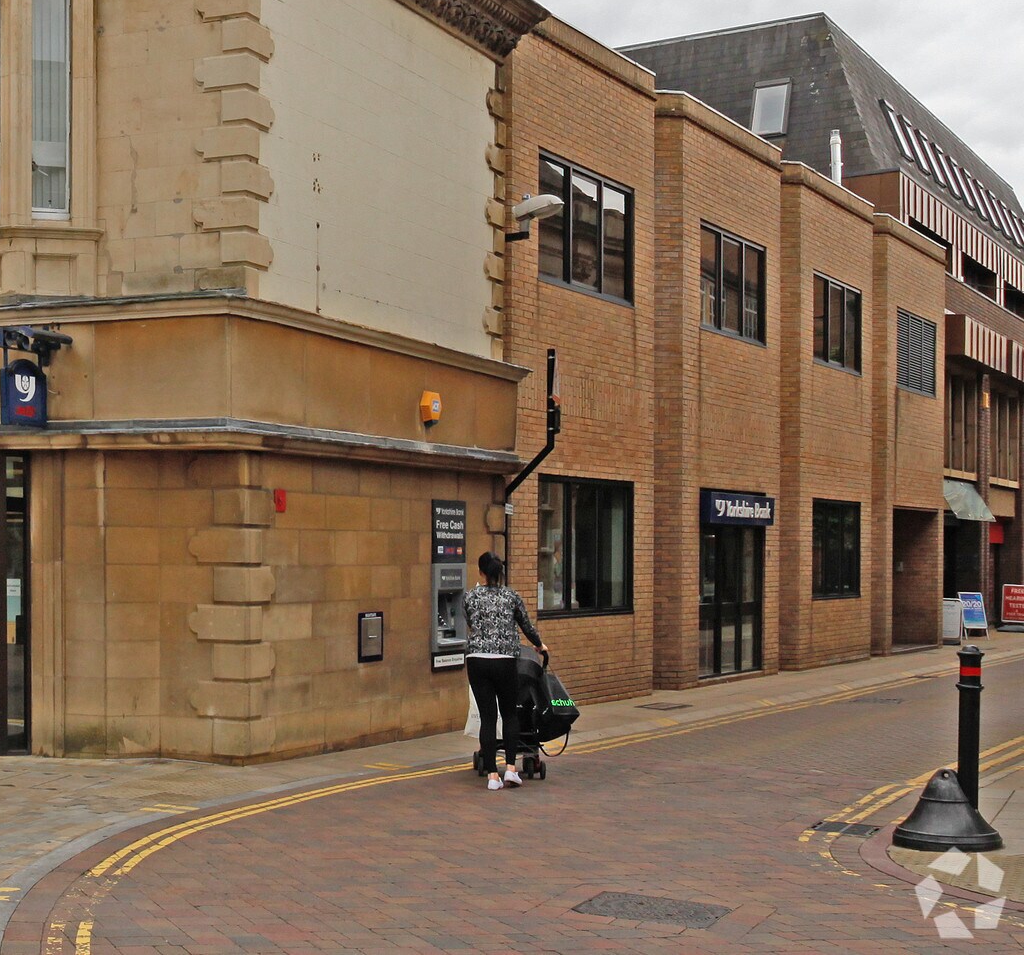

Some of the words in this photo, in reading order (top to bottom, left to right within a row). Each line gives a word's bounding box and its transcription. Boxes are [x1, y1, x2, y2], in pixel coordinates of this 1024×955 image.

[726, 500, 754, 518] Yorkshire
[754, 502, 771, 519] Bank
[436, 519, 449, 529] Free
[449, 520, 464, 530] Cash
[436, 531, 464, 539] Withdrawals
